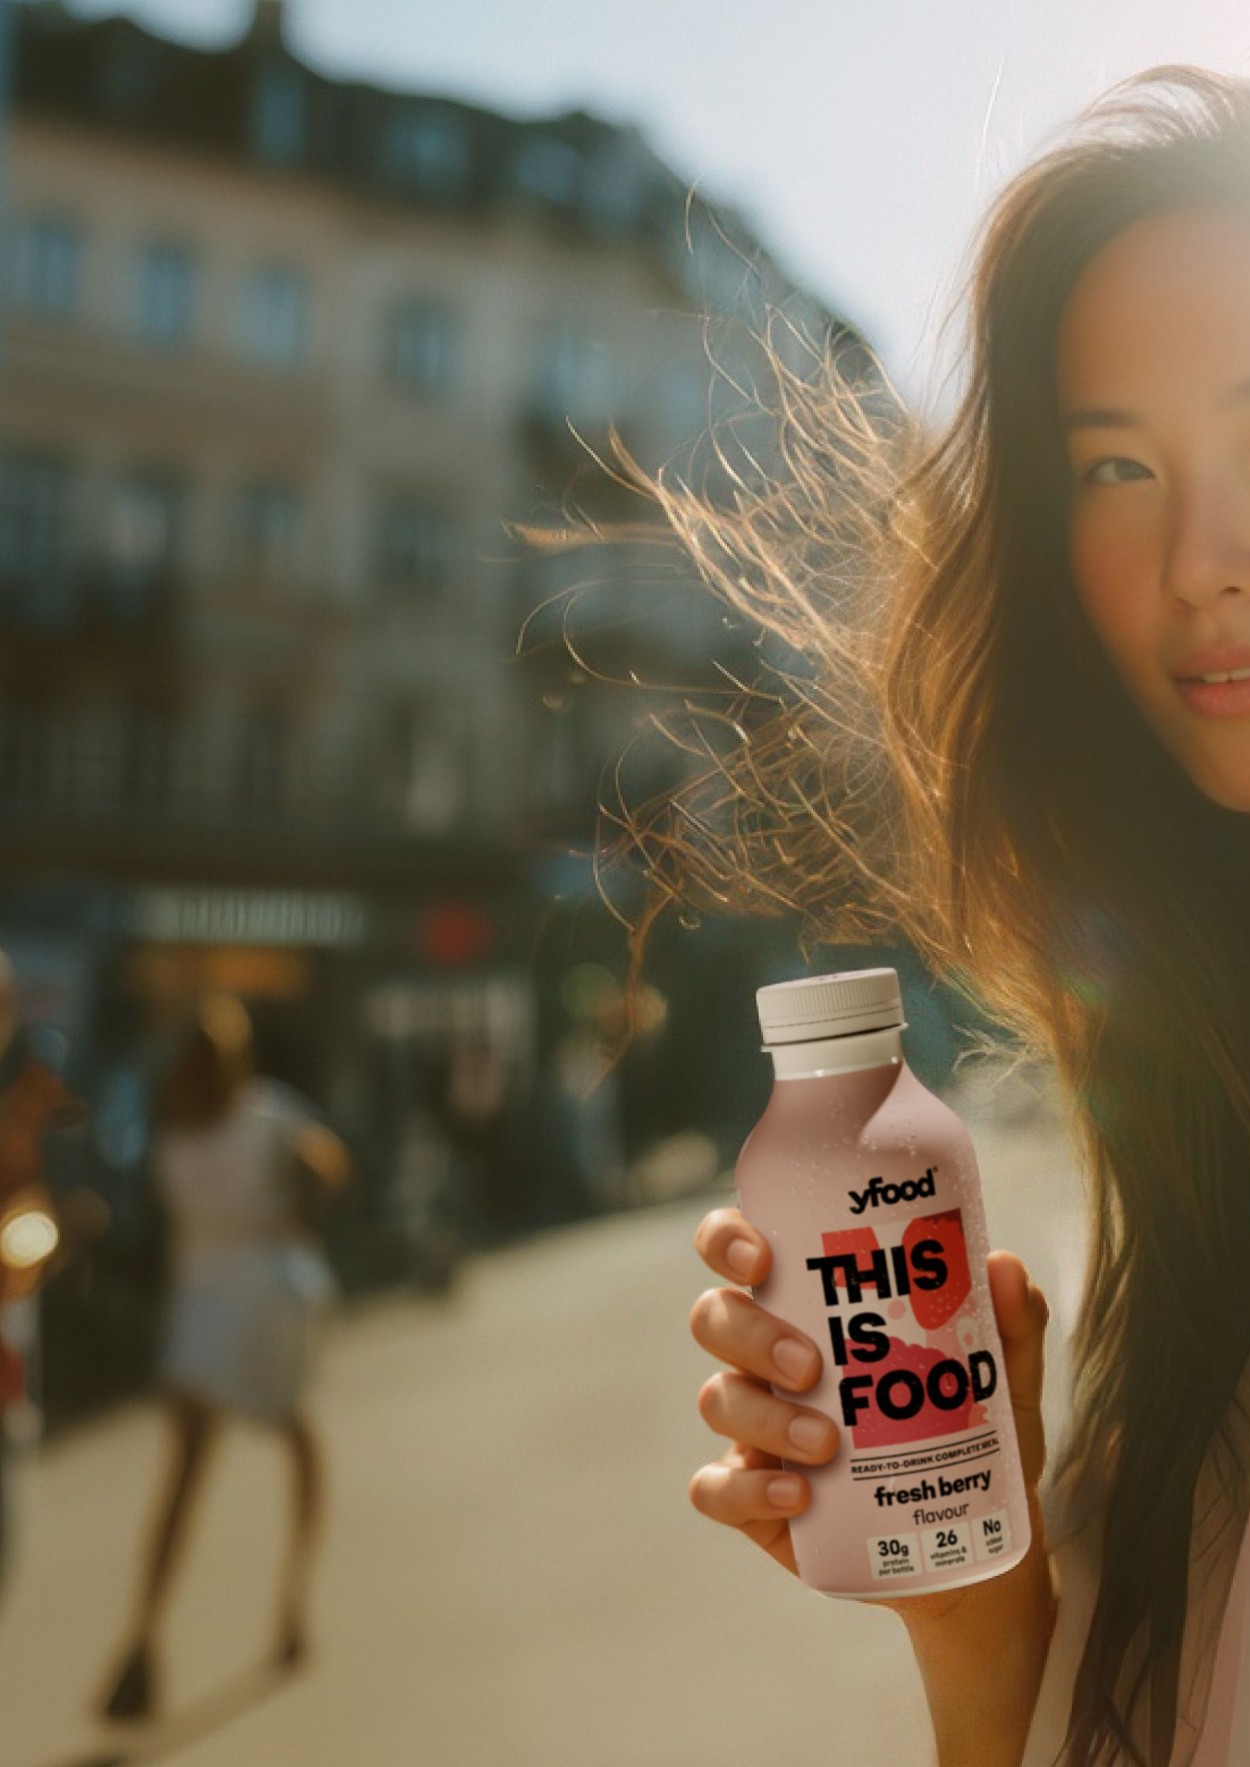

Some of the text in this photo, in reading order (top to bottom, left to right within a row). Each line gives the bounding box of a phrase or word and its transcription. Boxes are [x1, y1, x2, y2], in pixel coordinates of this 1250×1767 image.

[806, 1239, 948, 1306] THIS
[828, 1312, 890, 1366] IS
[839, 1350, 997, 1427] FOOD
[851, 1456, 934, 1474] READY-TO-DRINK
[935, 1443, 980, 1462] COMPLETE
[874, 1470, 991, 1506] fresh berry
[913, 1503, 970, 1525] flavour
[983, 1519, 1001, 1536] No
[878, 1539, 909, 1557] 30g
[936, 1529, 957, 1548] 26
[883, 1558, 909, 1568] protein
[930, 1549, 960, 1560] vitamins
[935, 1556, 965, 1567] minerals
